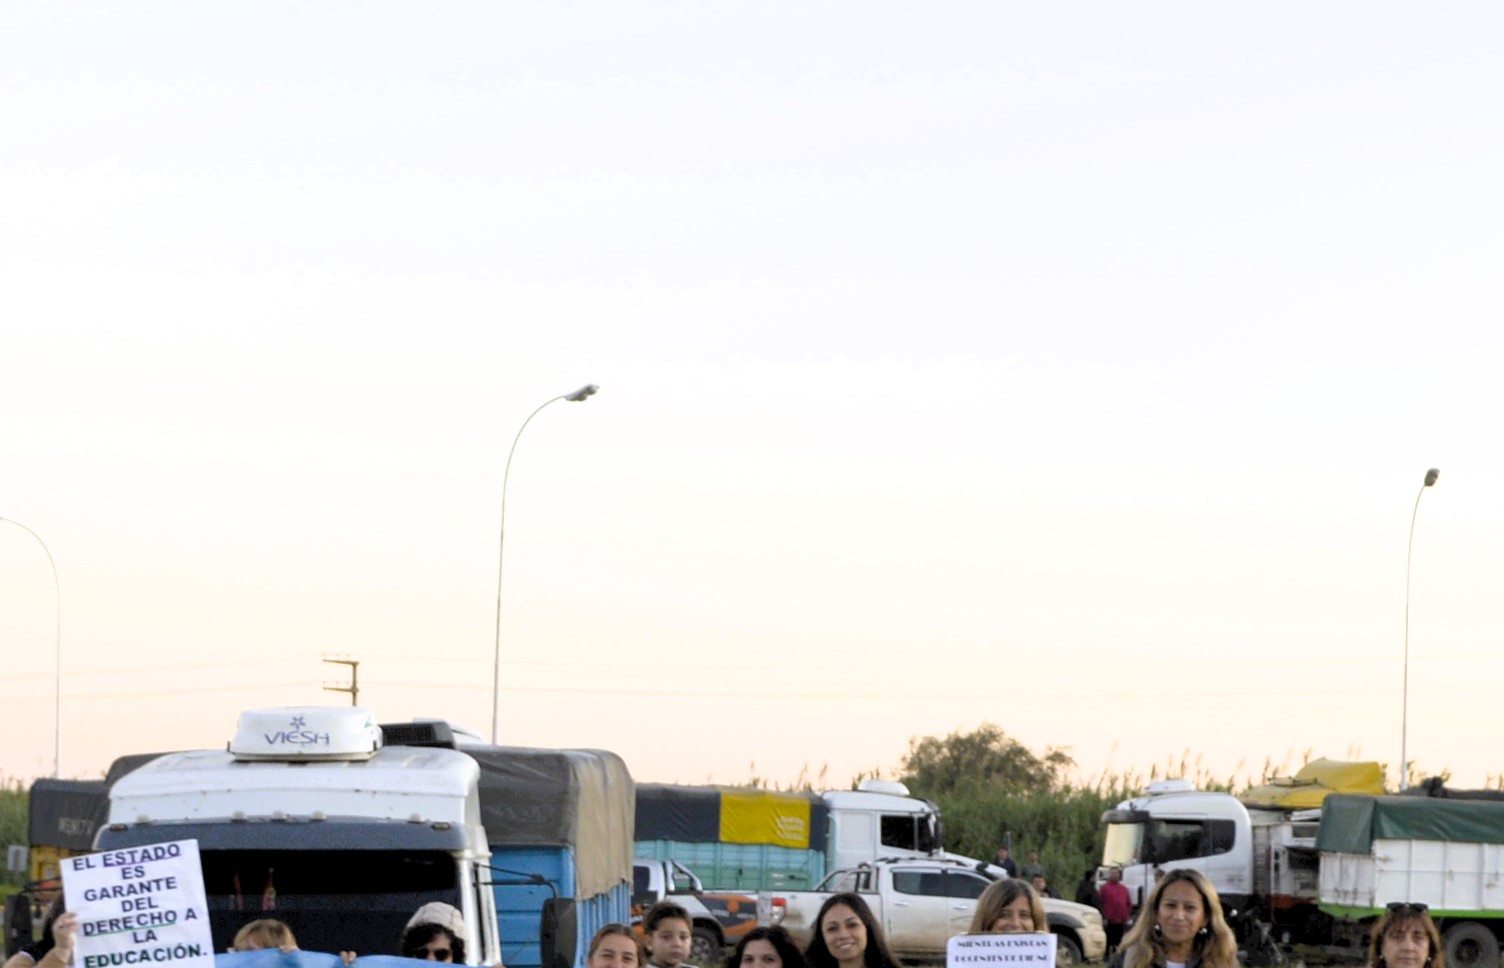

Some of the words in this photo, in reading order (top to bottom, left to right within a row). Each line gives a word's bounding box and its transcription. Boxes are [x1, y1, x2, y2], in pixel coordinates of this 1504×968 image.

[264, 730, 330, 745] VIESH
[73, 857, 96, 871] EL
[103, 843, 181, 868] ESTADO
[121, 866, 145, 880] ES
[84, 876, 178, 902] GARANTE
[122, 897, 158, 913] DEL
[83, 910, 177, 937] DERECHO
[184, 907, 198, 921] A
[133, 929, 158, 944] LA
